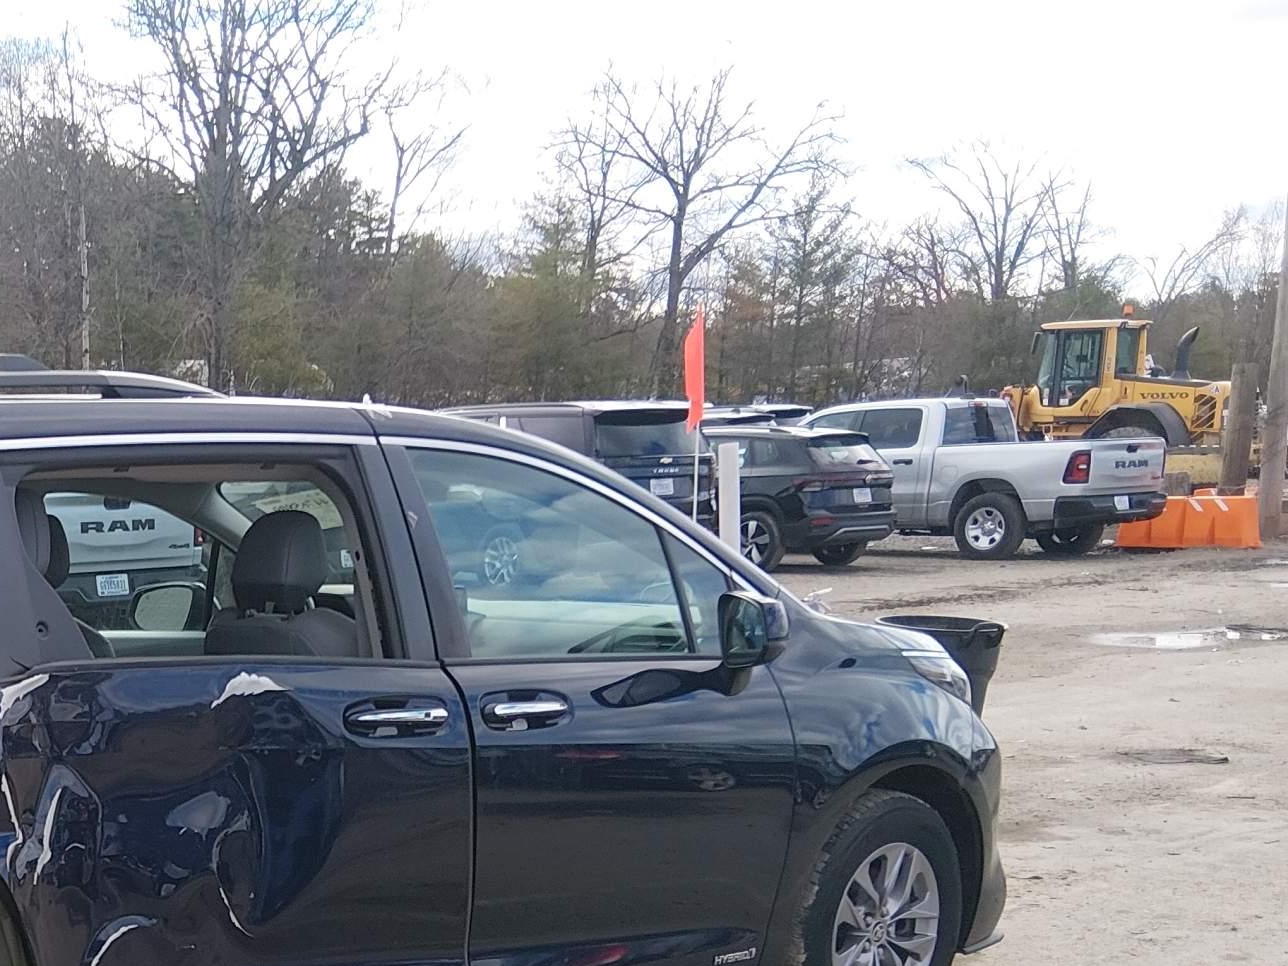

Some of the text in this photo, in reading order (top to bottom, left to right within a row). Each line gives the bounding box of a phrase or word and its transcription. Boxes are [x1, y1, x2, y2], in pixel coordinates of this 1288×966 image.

[1140, 391, 1189, 399] VOLVO
[1115, 460, 1149, 469] RAM
[80, 518, 156, 534] RAM
